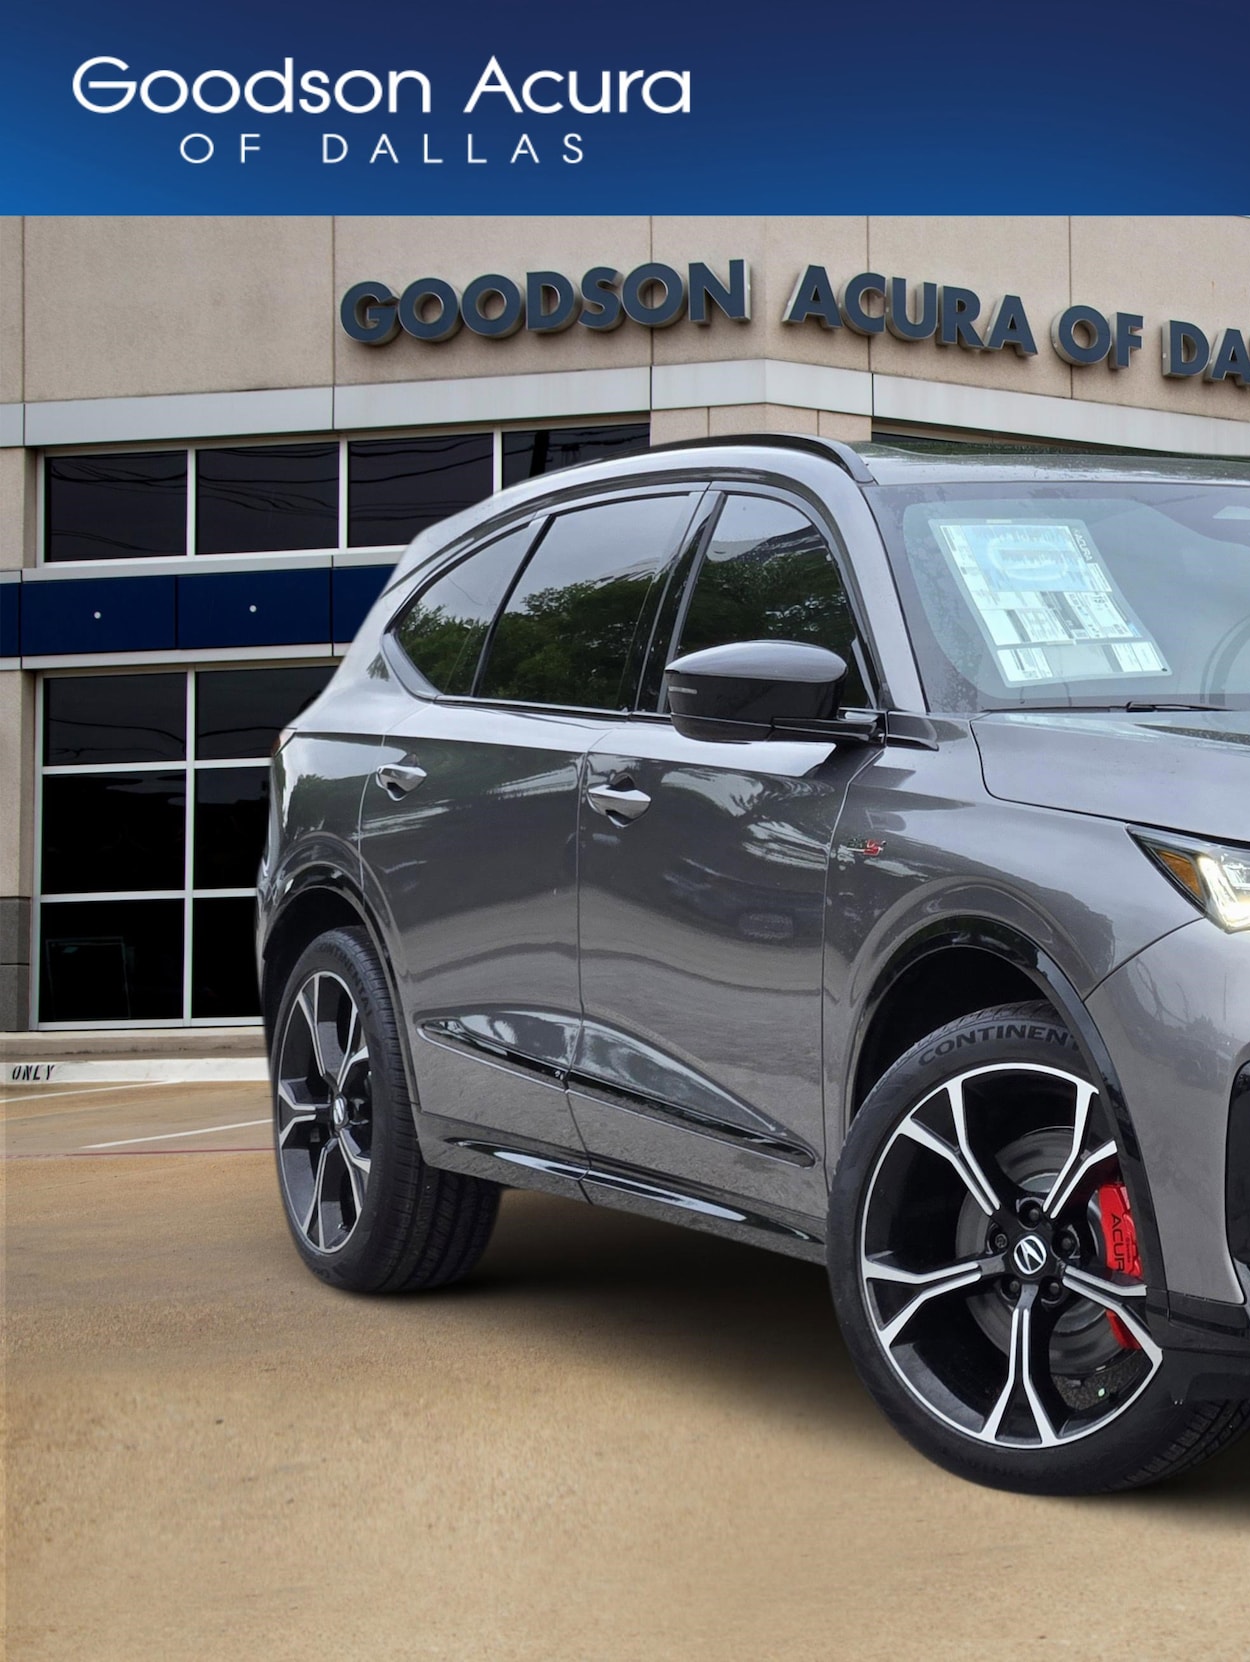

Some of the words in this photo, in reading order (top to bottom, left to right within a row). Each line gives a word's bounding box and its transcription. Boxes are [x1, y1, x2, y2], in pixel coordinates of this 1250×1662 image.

[340, 258, 751, 345] GOODSON
[782, 263, 1038, 357] ACURA
[1051, 304, 1144, 369] OF
[12, 1064, 56, 1081] ONLY
